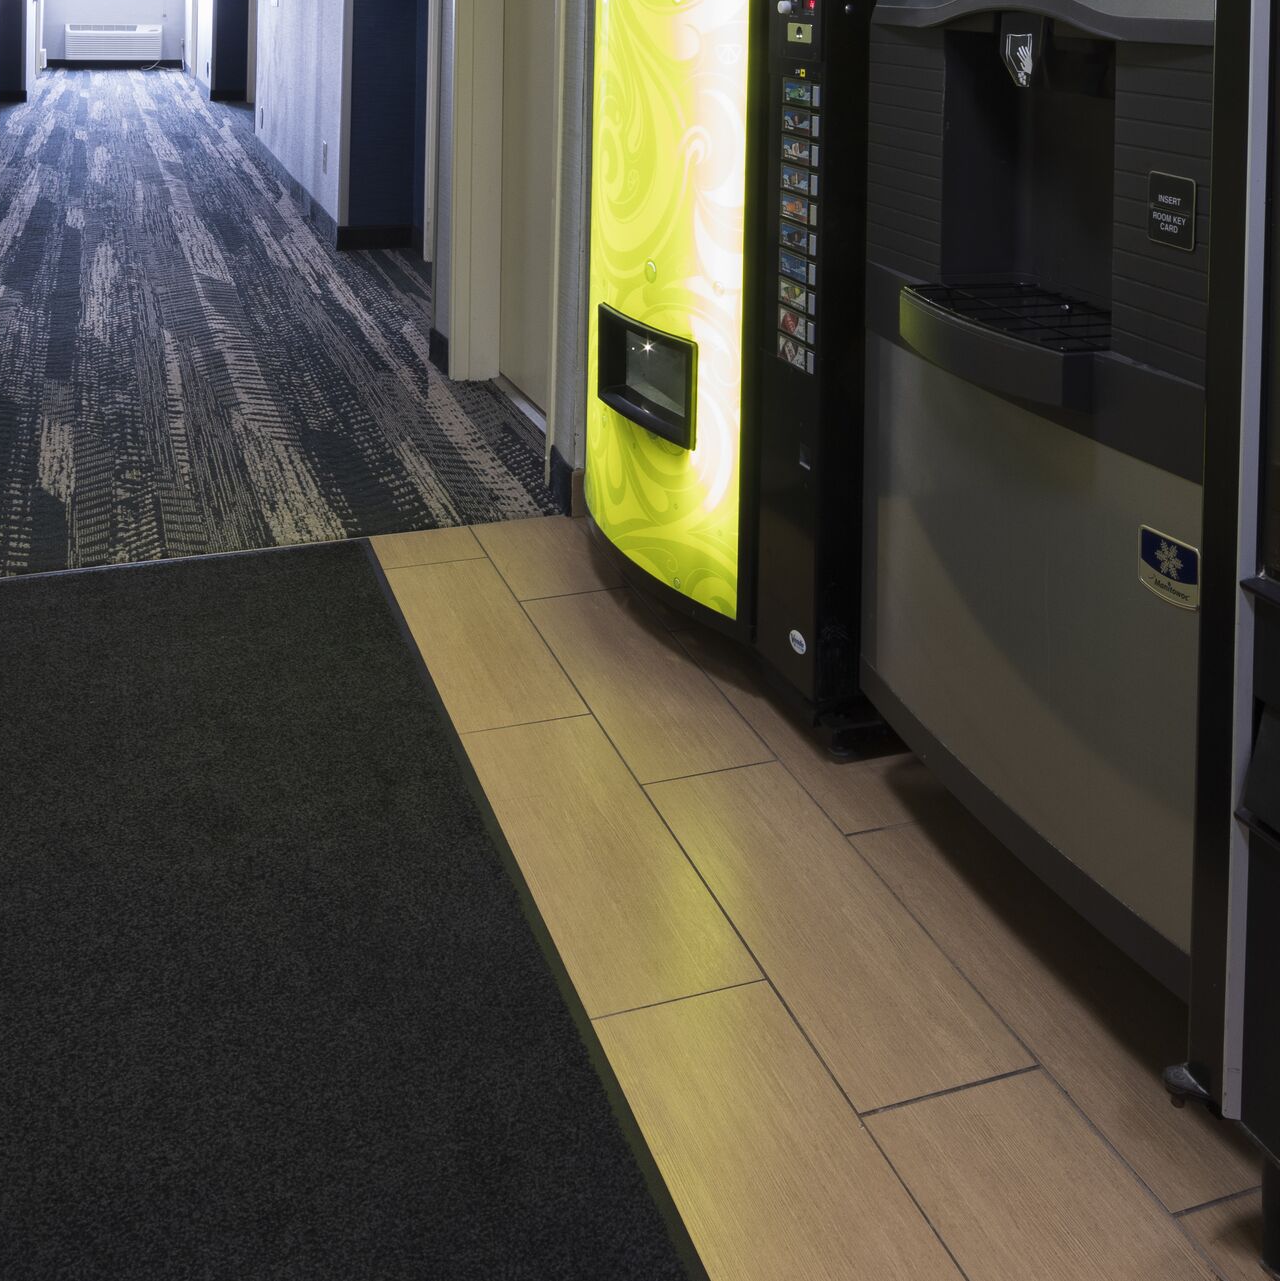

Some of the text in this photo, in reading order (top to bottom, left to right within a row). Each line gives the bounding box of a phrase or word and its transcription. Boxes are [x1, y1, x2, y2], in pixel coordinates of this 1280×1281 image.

[1158, 194, 1181, 206] INSERT
[1152, 211, 1186, 226] ROOM KEY
[1160, 222, 1179, 234] CARD
